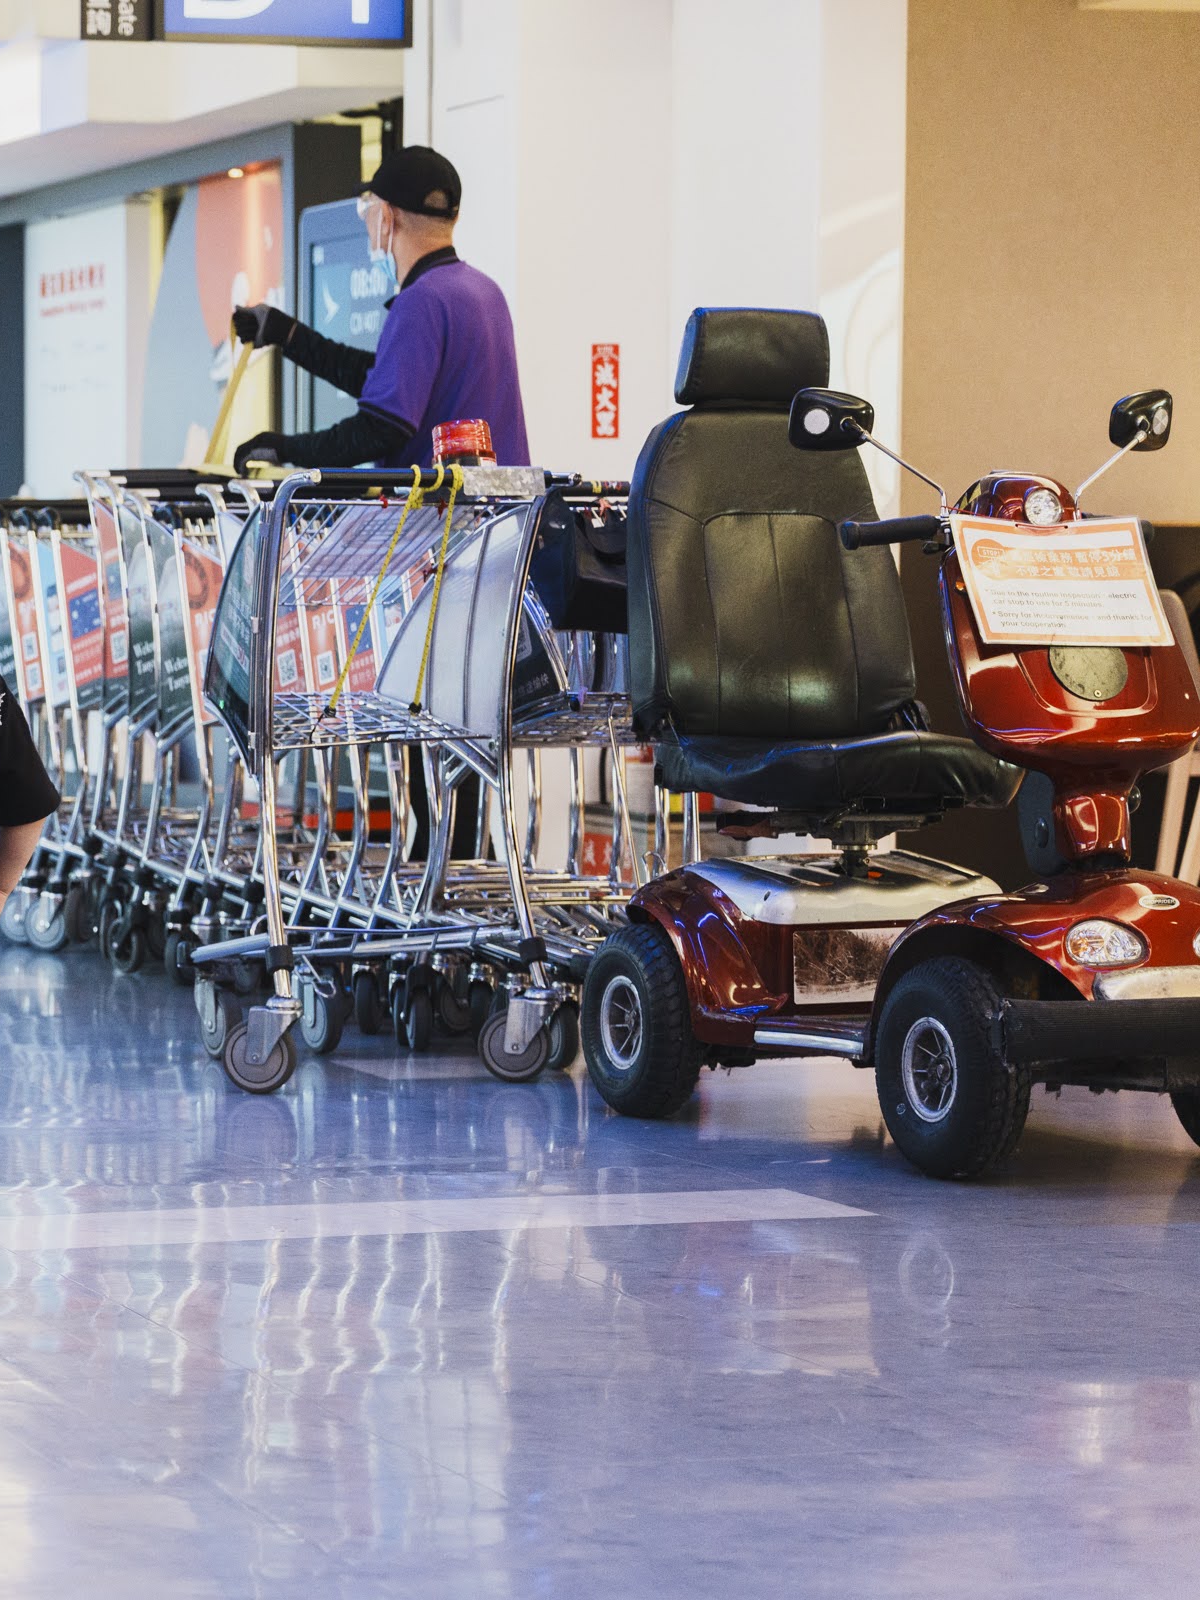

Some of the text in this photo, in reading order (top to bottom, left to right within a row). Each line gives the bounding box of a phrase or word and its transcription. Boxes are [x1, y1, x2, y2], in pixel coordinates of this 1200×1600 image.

[118, 0, 138, 36] ate
[1108, 592, 1137, 600] electric
[1008, 599, 1024, 608] stop
[998, 611, 1019, 620] Sorry
[1020, 611, 1032, 619] for
[1097, 613, 1112, 621] and
[1113, 613, 1139, 621] thanks
[1001, 621, 1018, 629] your
